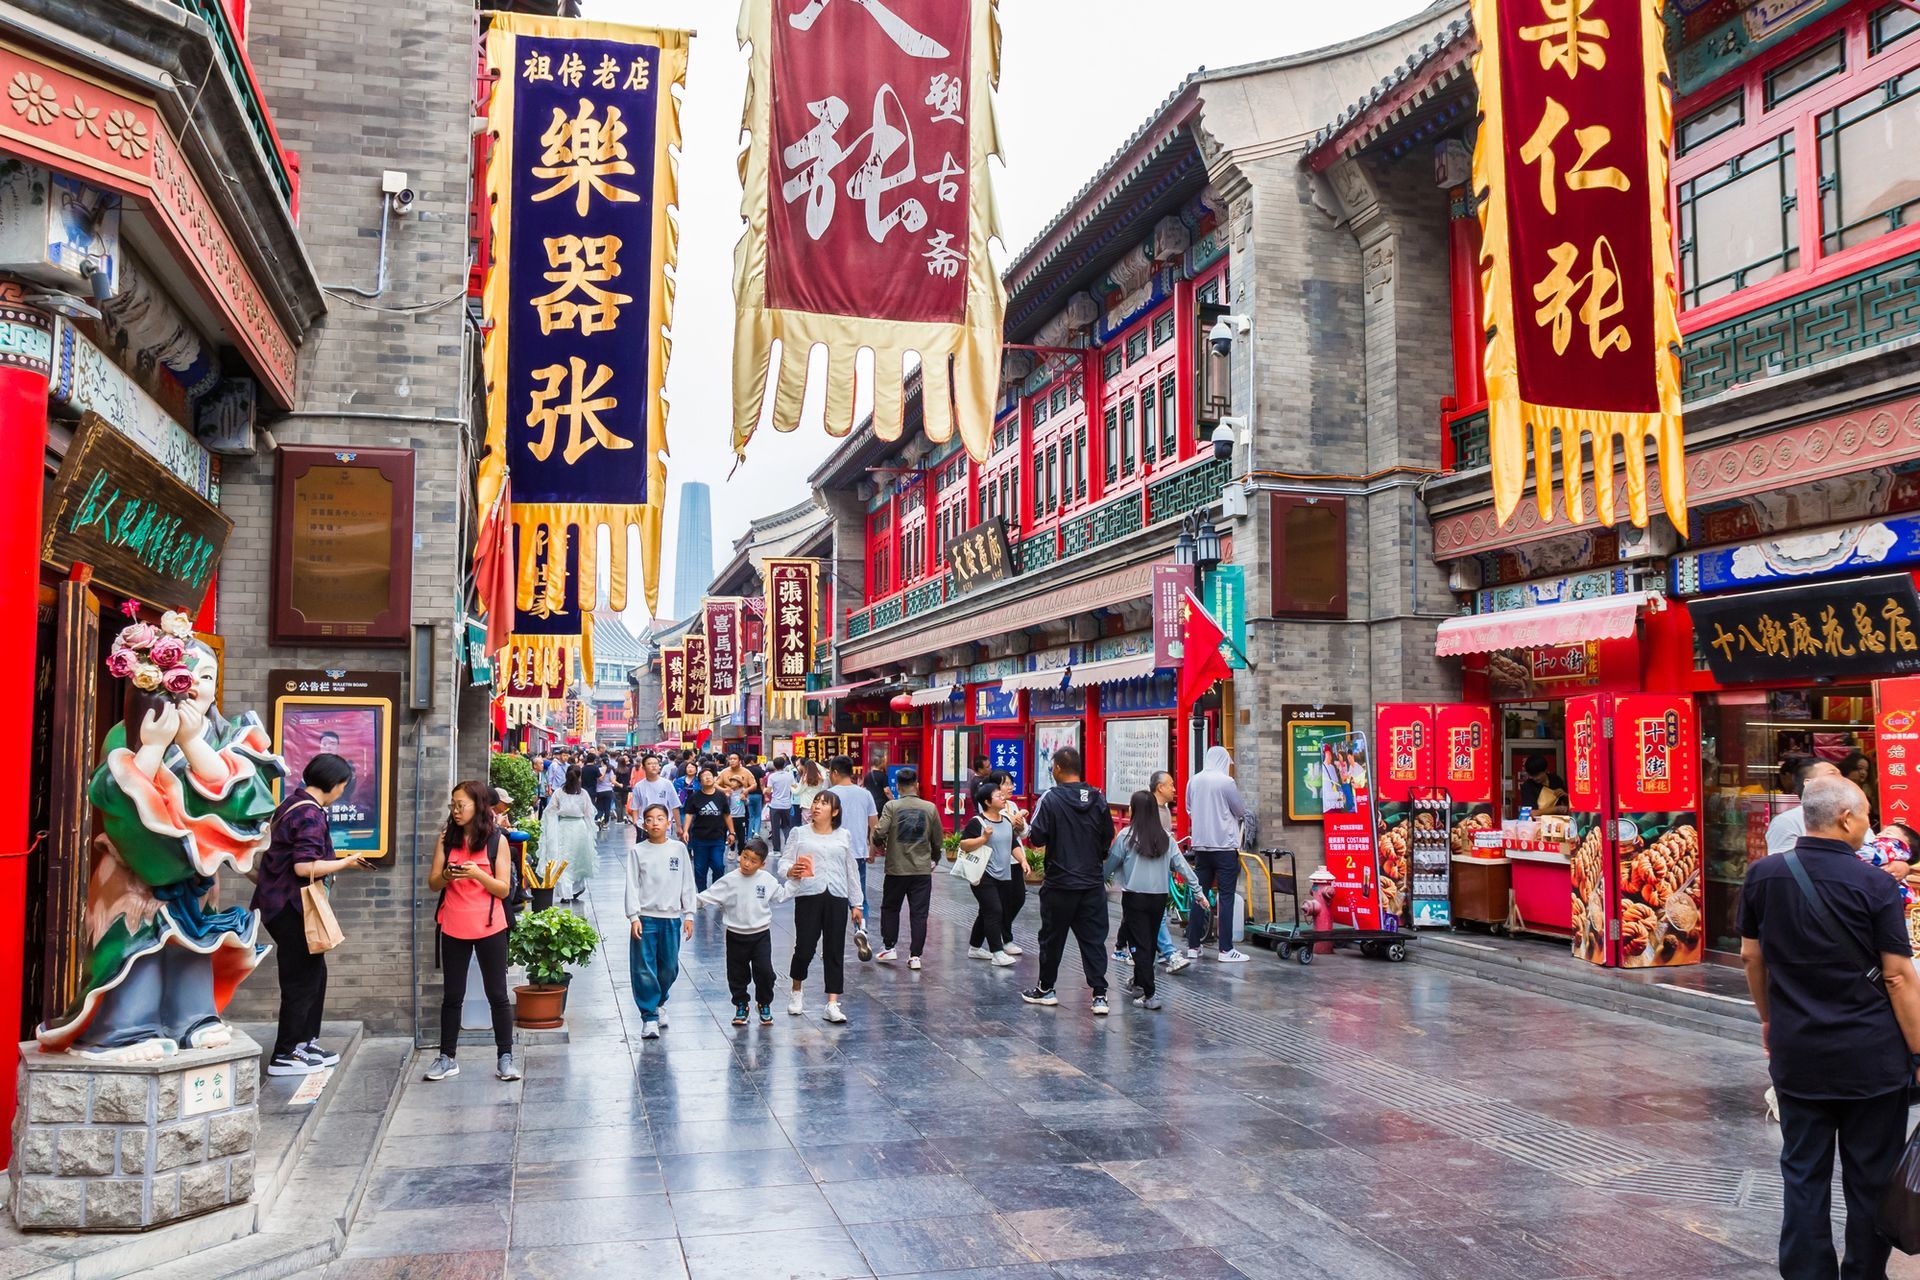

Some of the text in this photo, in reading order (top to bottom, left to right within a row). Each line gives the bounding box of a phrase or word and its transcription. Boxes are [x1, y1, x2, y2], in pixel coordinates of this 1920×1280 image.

[522, 50, 651, 92] 祖传老店
[921, 72, 968, 279] 塑古斋
[1535, 648, 1589, 675] 十八街
[299, 681, 330, 692] 公告栏
[1007, 744, 1018, 791] 文房四
